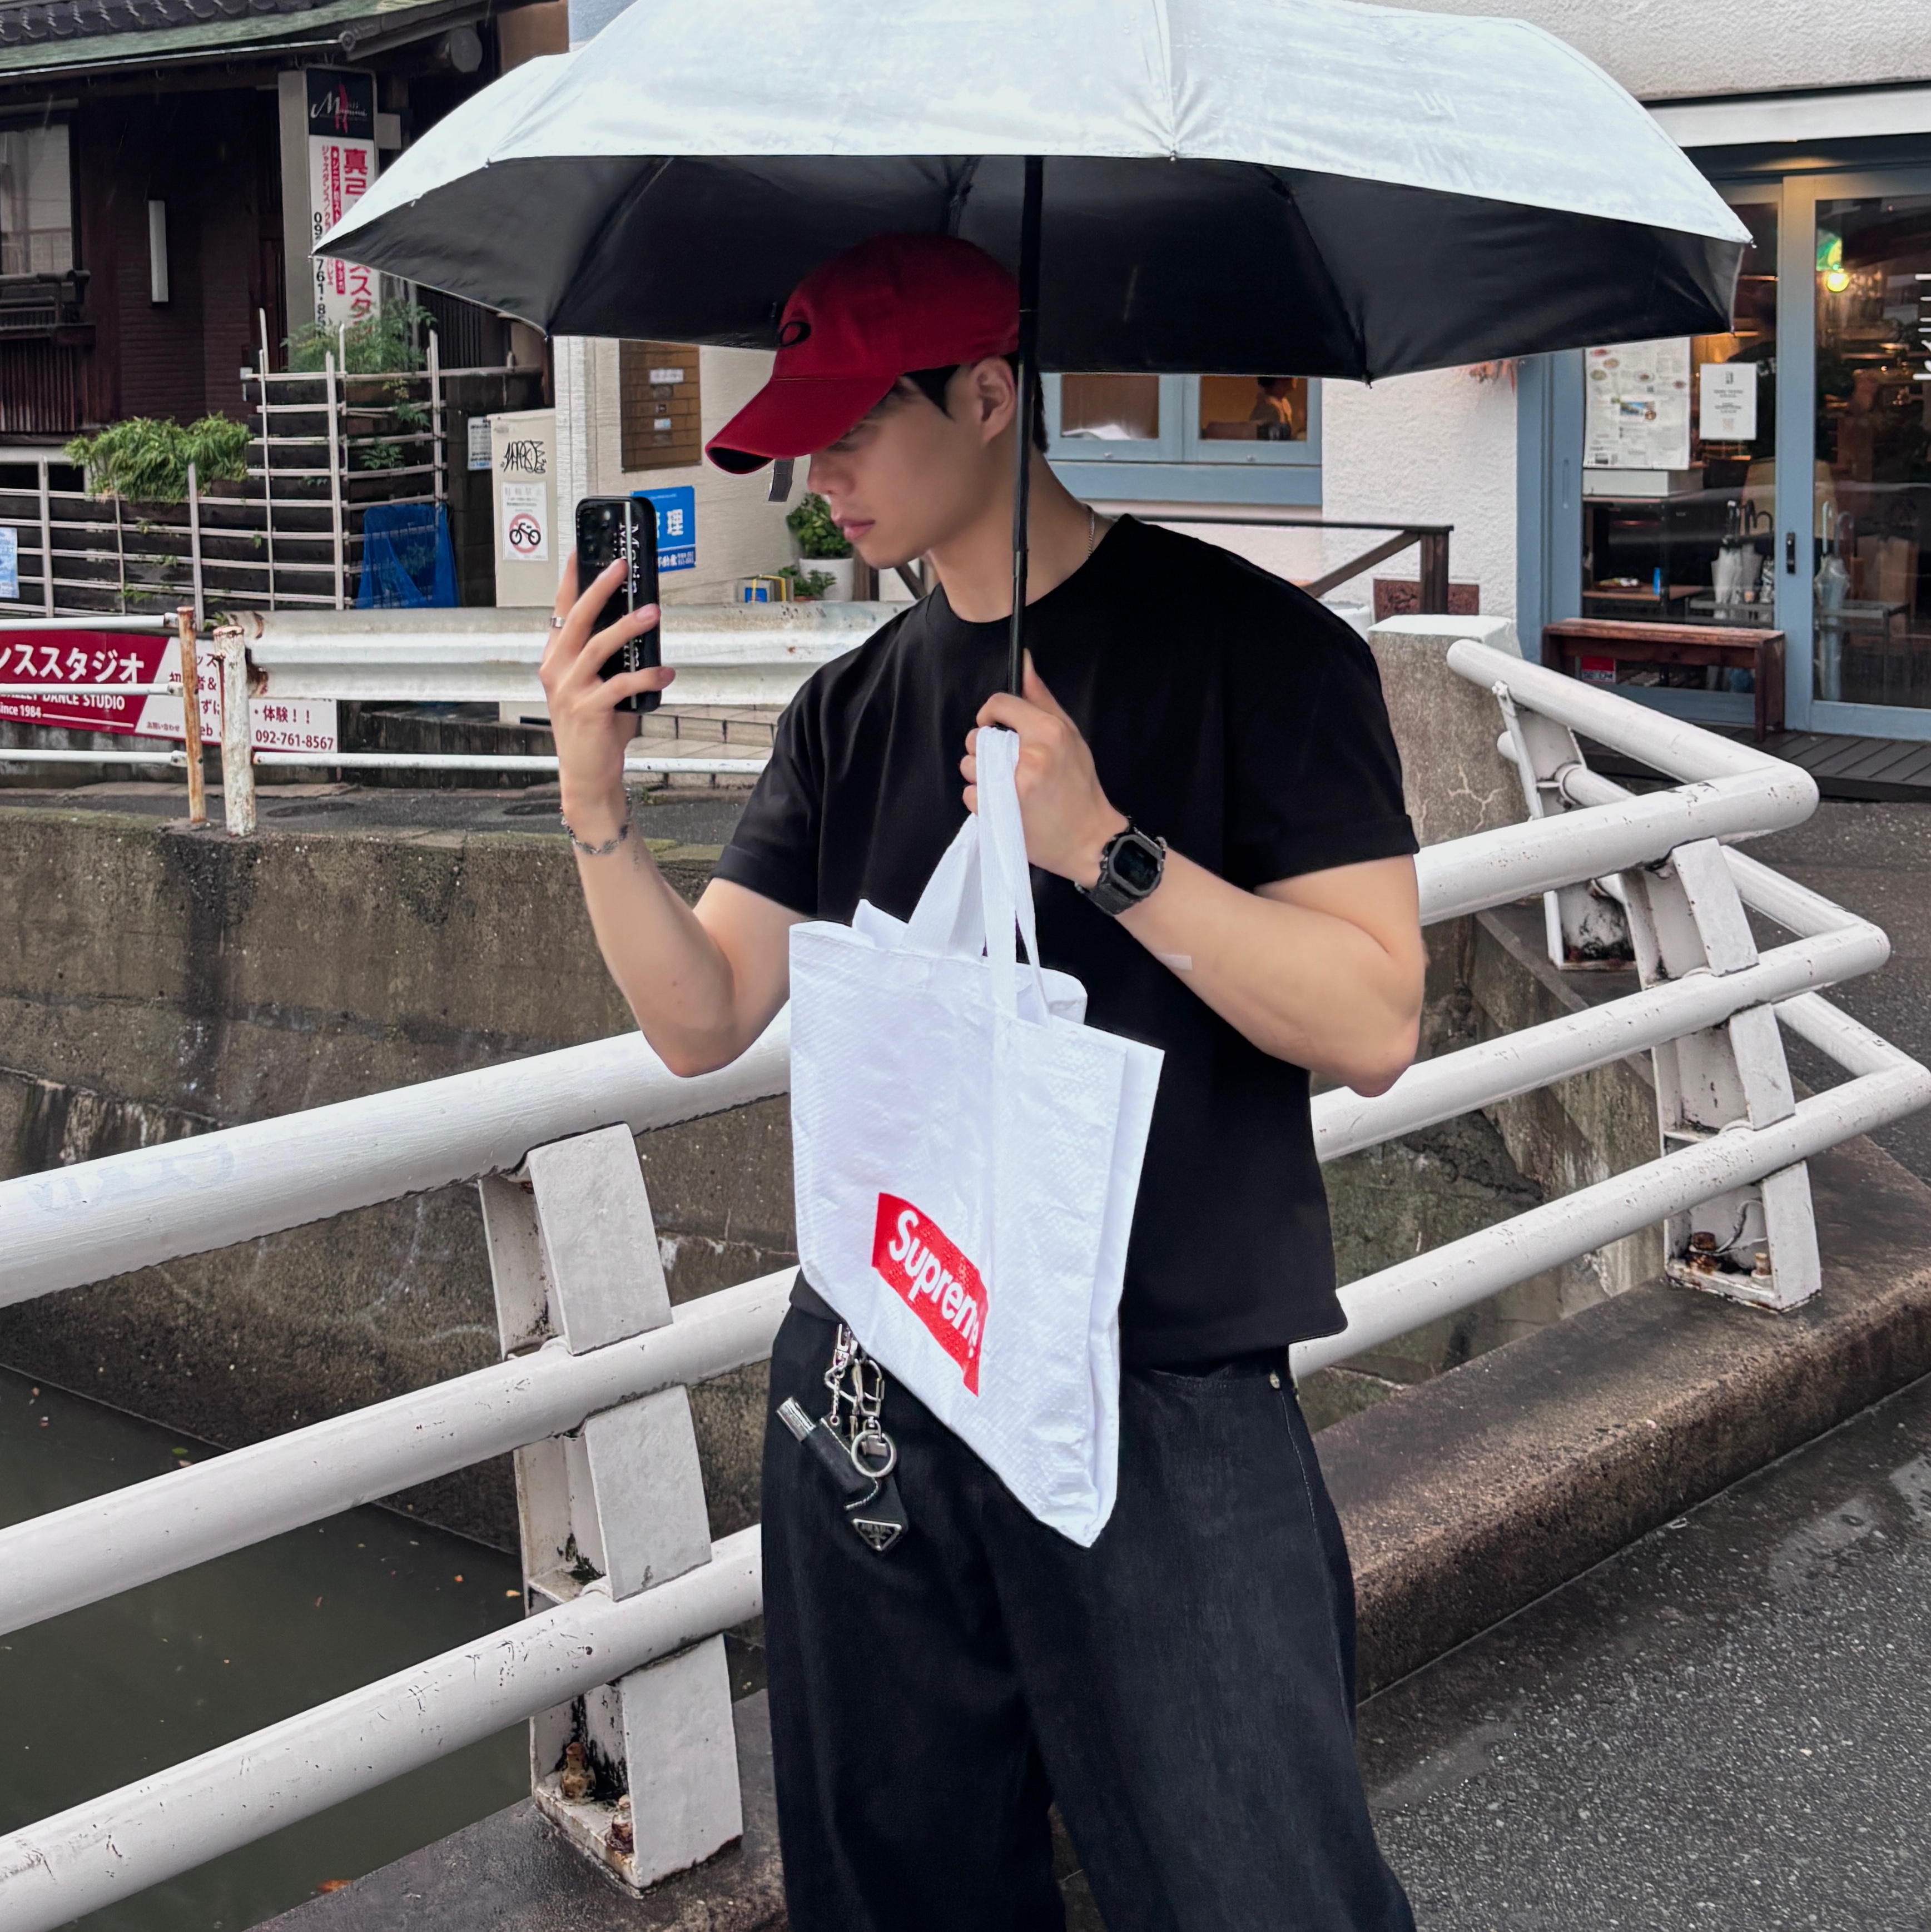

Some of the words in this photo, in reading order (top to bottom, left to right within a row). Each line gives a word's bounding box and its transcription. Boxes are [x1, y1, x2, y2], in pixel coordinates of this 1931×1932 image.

[19, 704, 42, 718] 1984
[83, 695, 126, 711] STUDIO
[255, 729, 334, 751] 092-761-8567
